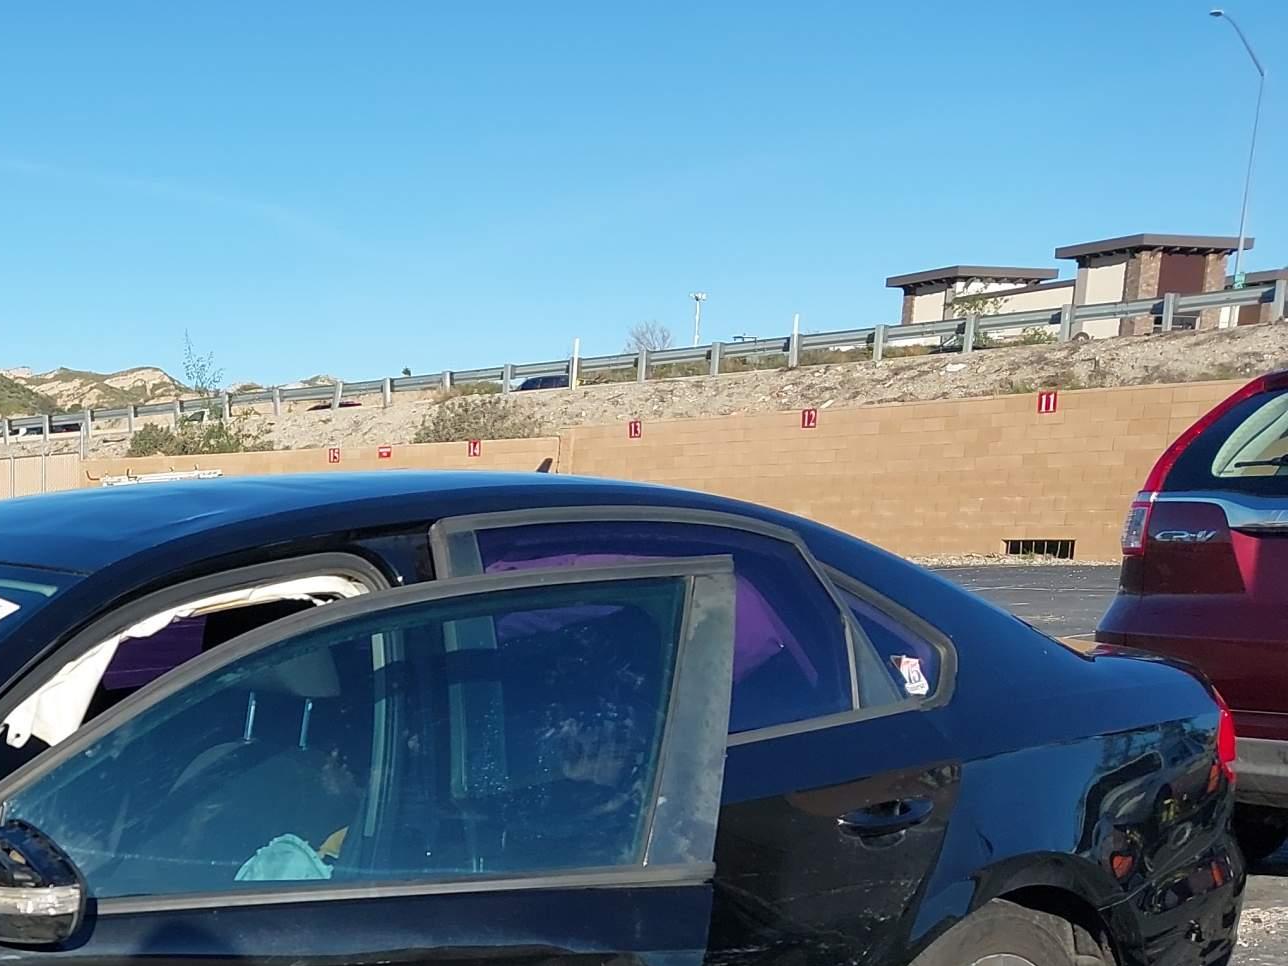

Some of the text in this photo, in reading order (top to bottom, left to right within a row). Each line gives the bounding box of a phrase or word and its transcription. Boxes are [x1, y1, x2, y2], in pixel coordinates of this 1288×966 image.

[1040, 393, 1055, 412] 11
[804, 410, 816, 427] 12
[631, 422, 641, 437] 13
[329, 448, 339, 462] 15
[470, 442, 480, 457] 14
[1154, 529, 1217, 543] CR-V
